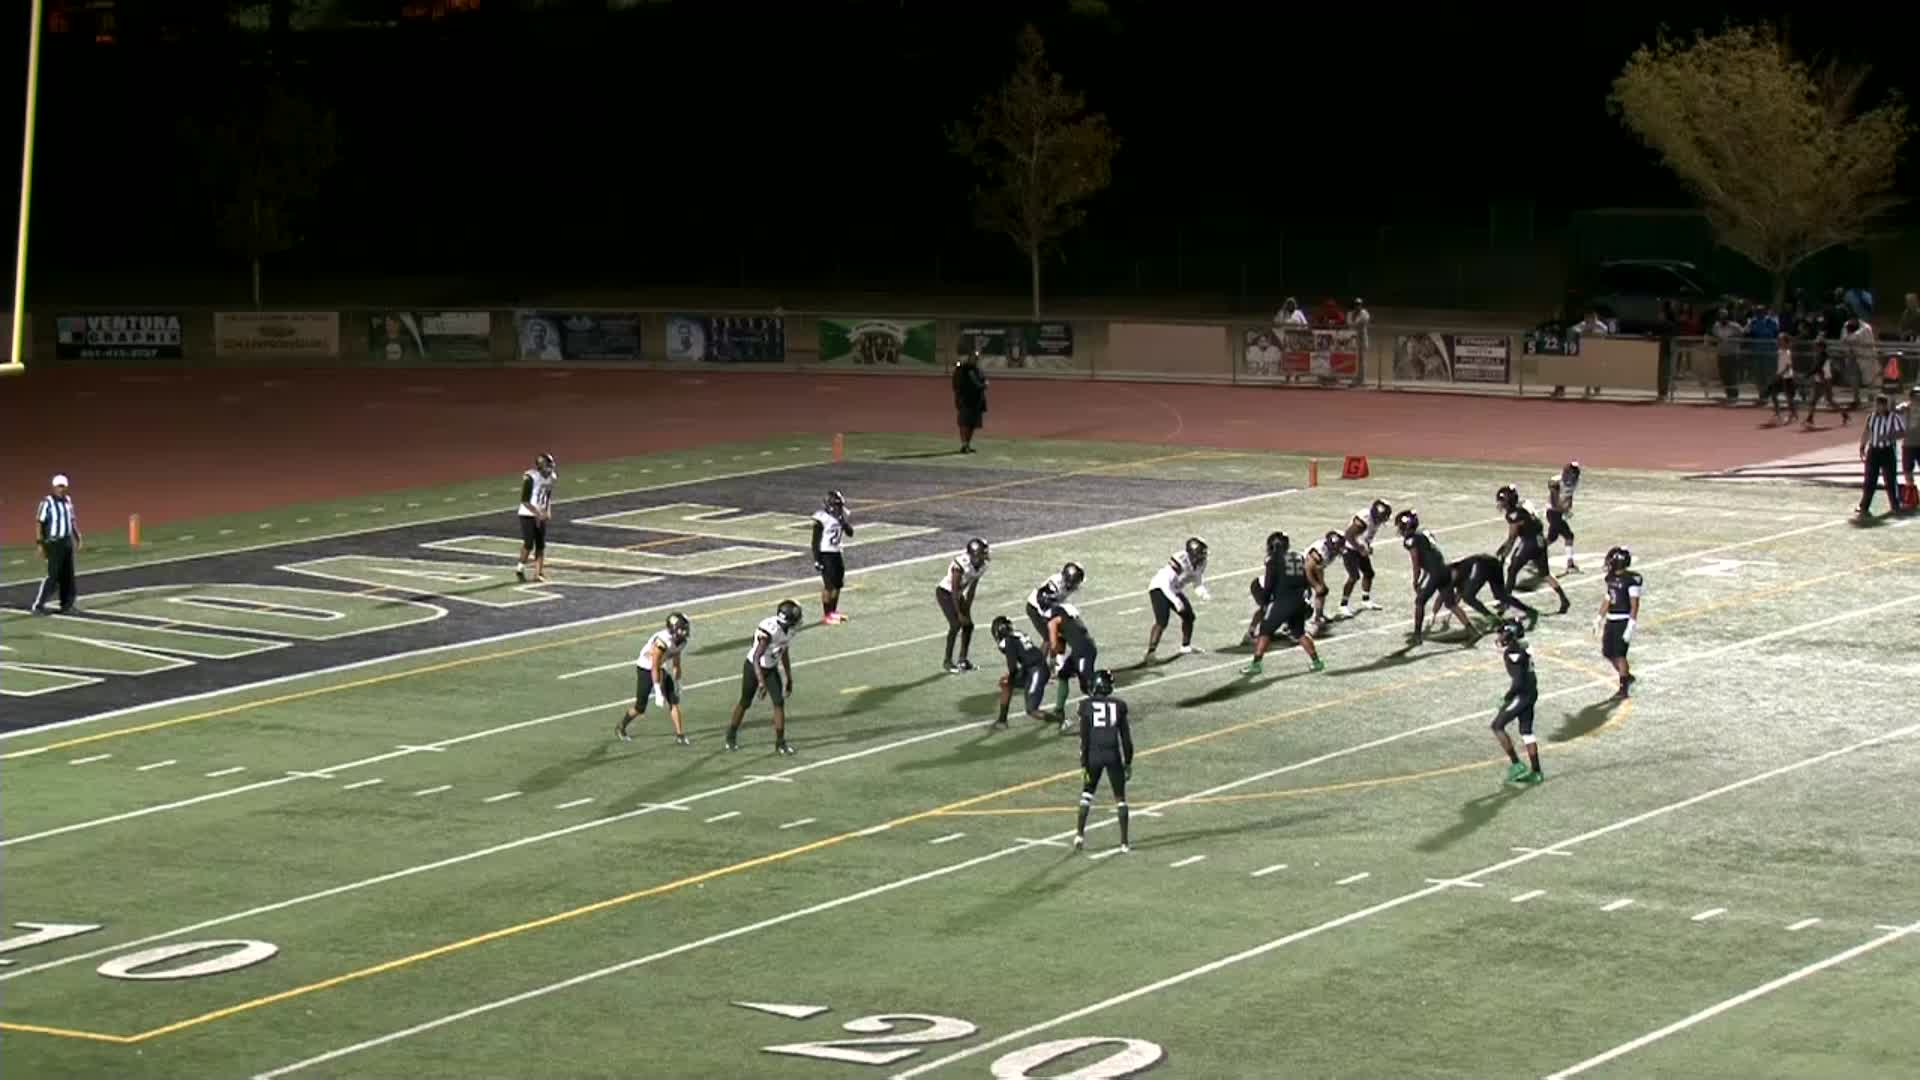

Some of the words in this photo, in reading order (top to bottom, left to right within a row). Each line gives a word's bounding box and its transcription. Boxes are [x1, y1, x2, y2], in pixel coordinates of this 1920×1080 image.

[87, 315, 181, 330] VENTURA
[1347, 457, 1362, 475] G
[1091, 702, 1117, 727] 21
[758, 1012, 1168, 1080] 20
